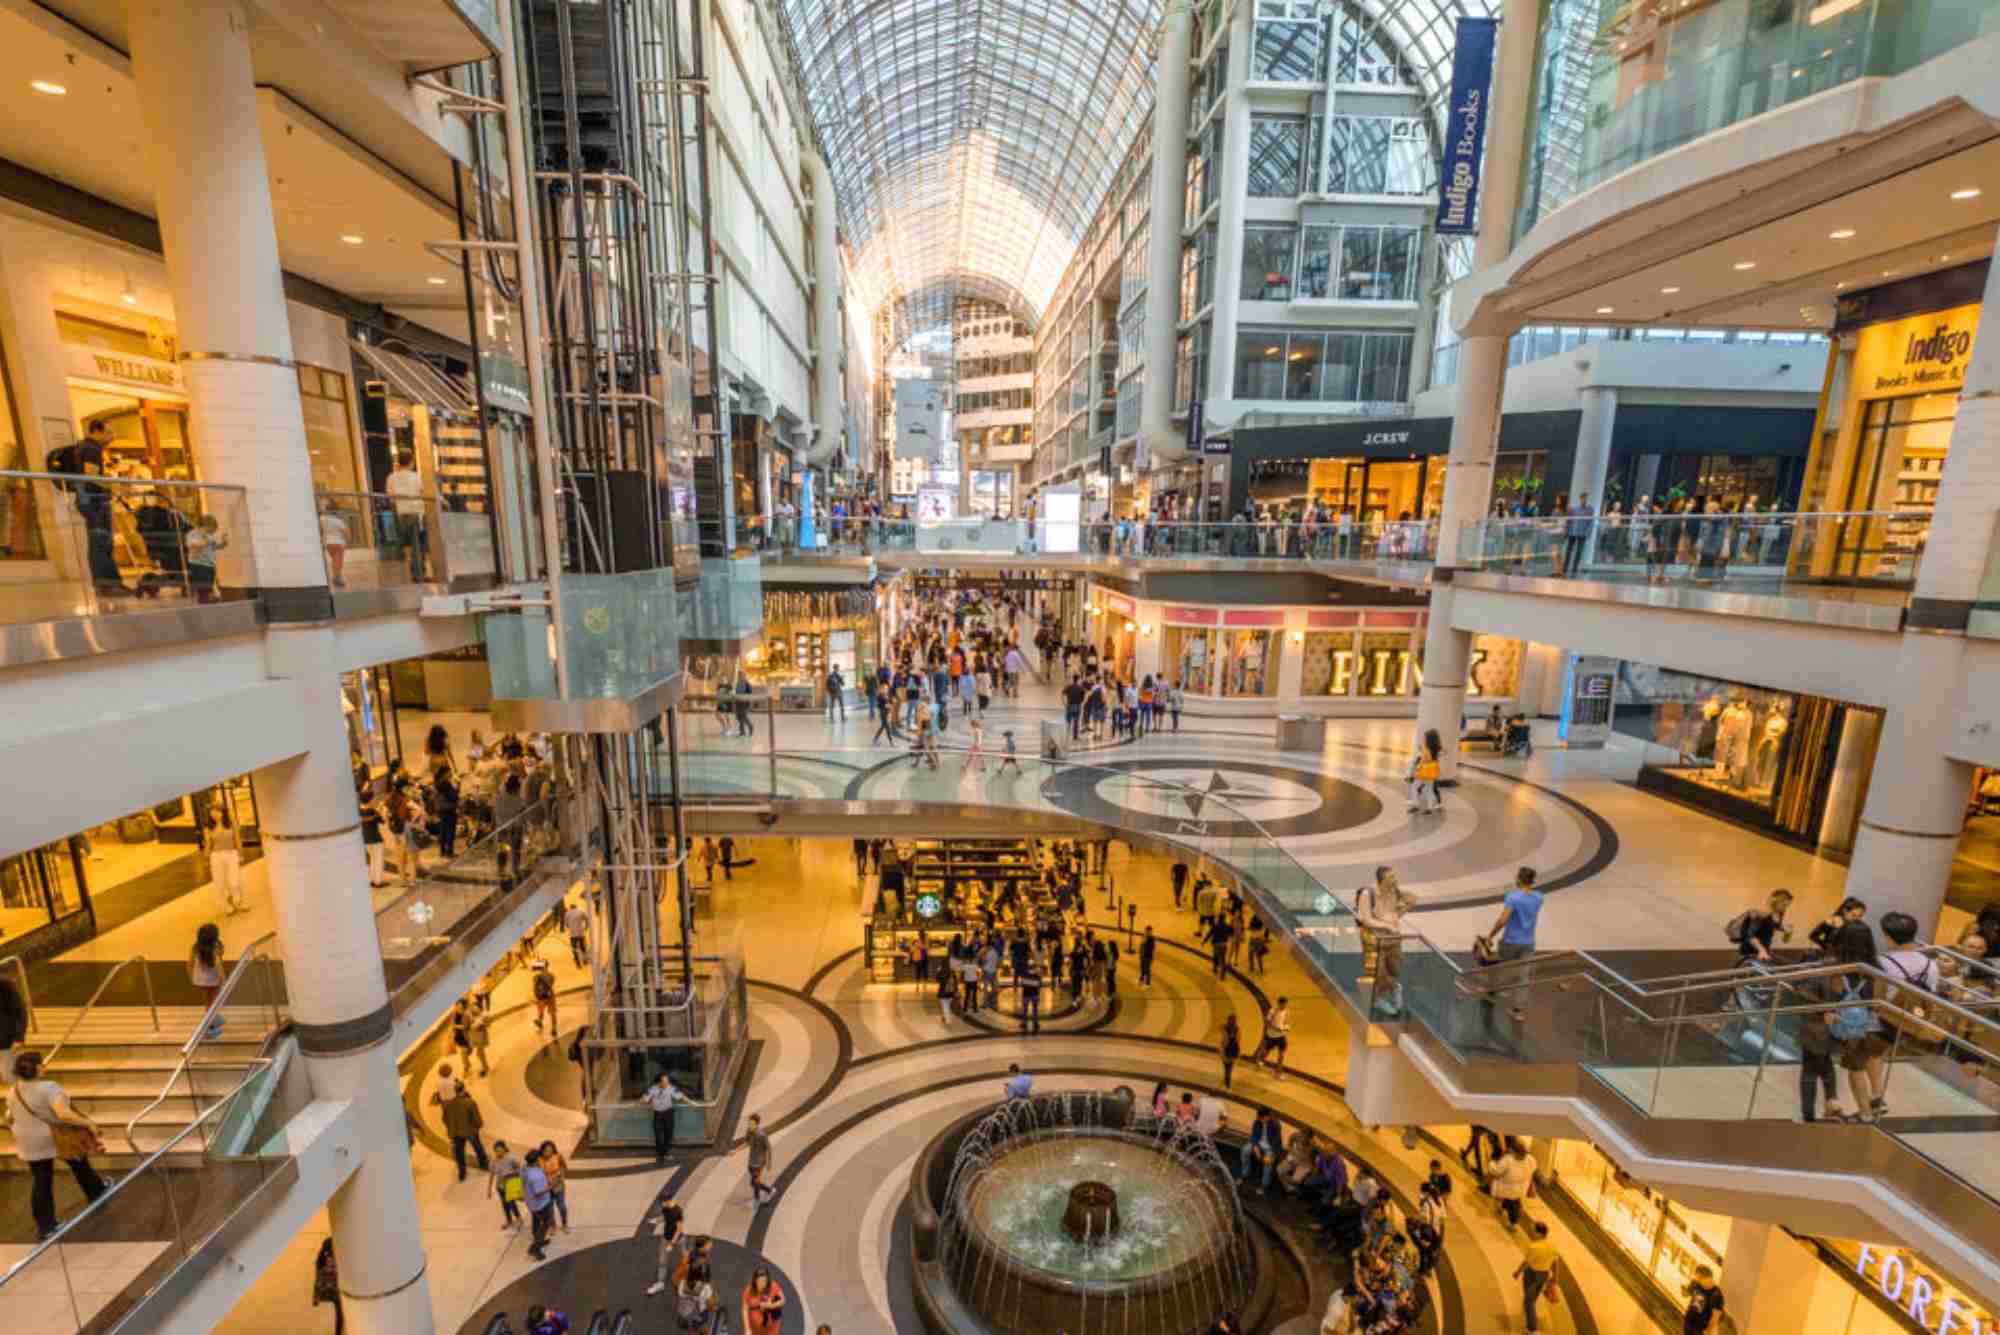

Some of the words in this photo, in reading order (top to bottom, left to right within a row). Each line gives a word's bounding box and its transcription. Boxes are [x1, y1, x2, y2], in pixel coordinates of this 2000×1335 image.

[1456, 88, 1480, 155] Books
[1440, 162, 1474, 226] Indigo
[1904, 325, 1970, 365] Indigo
[96, 359, 175, 385] WILLIAMS
